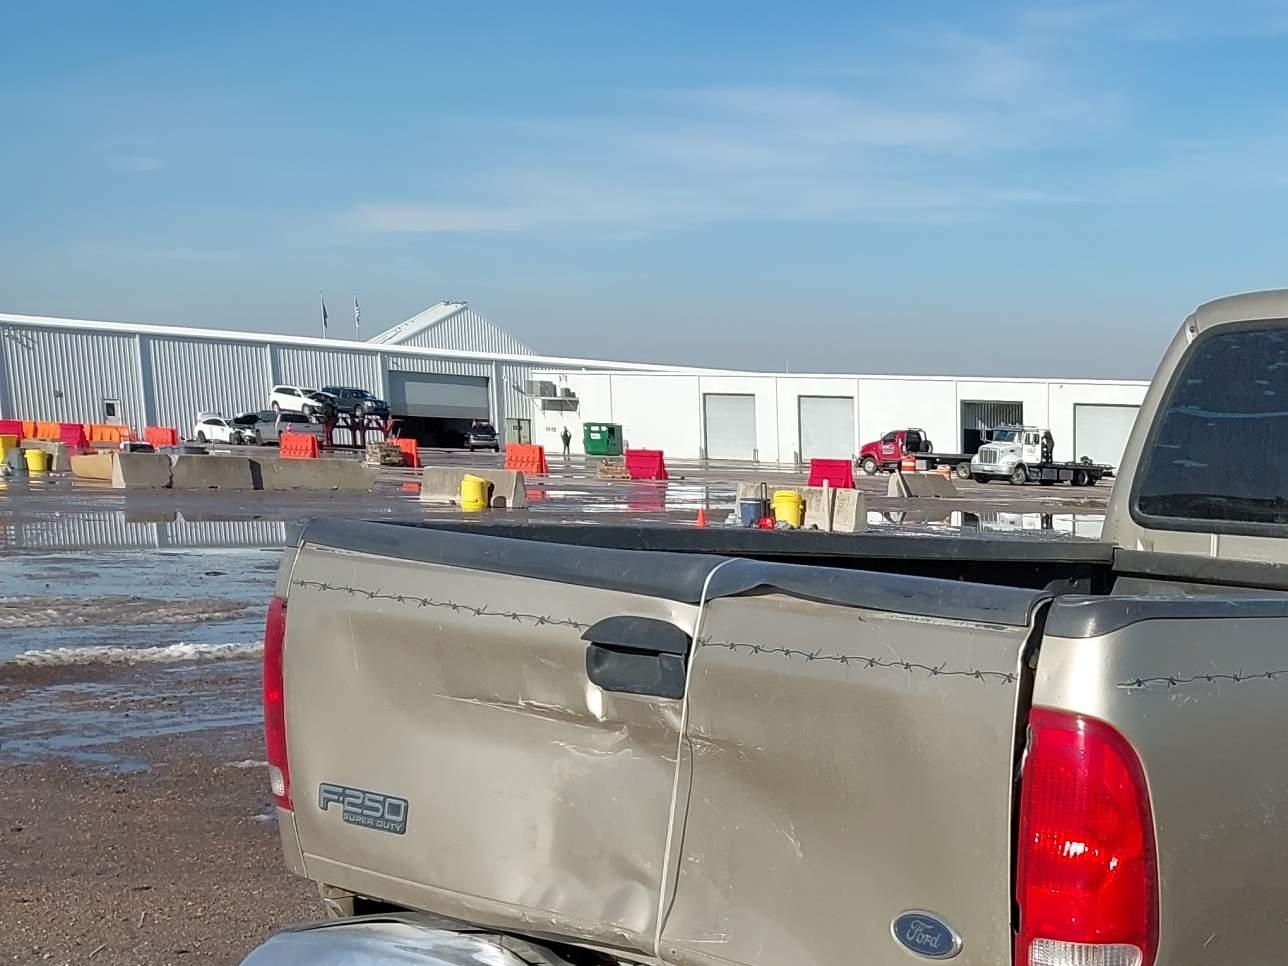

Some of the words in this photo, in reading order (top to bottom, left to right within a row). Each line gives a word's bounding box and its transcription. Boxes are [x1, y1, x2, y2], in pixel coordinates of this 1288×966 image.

[343, 812, 374, 826] SUPER
[375, 820, 403, 832] DUTY
[906, 919, 942, 949] Ford
